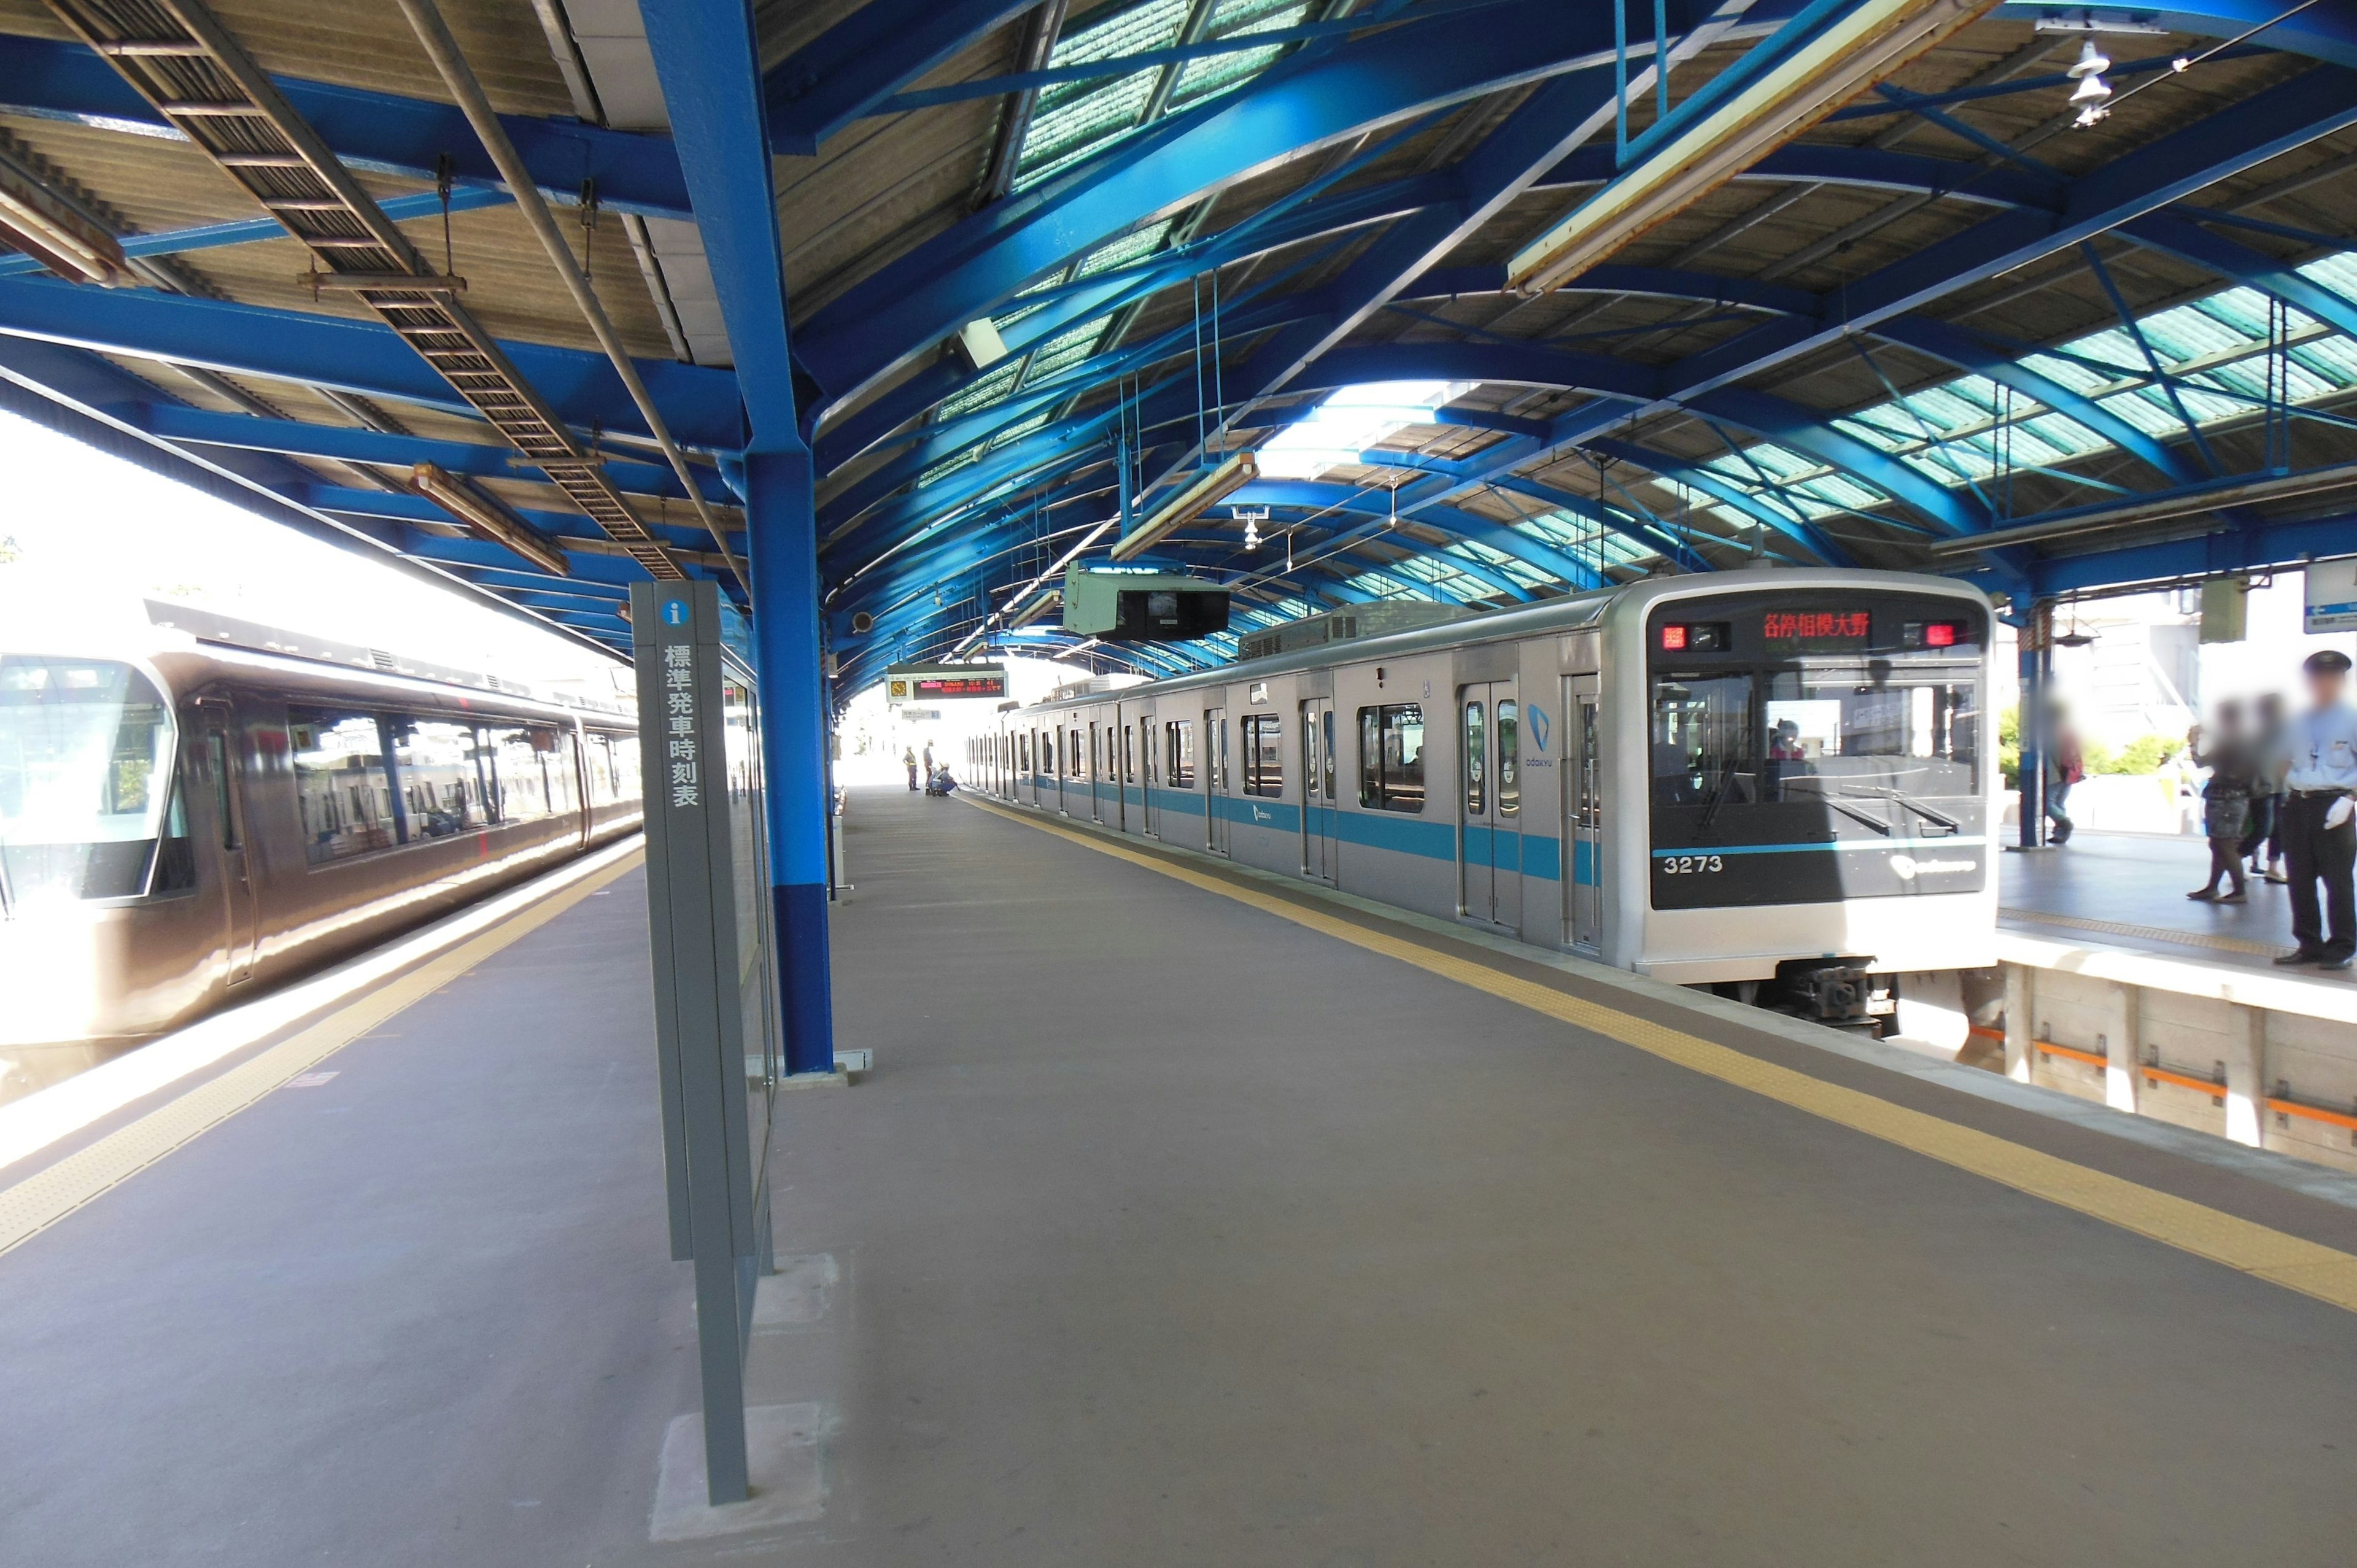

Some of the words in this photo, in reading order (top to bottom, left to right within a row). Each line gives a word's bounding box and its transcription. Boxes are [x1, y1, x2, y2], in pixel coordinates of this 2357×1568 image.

[1764, 612, 1870, 638] 各停相模大野
[665, 646, 699, 808] 標準発車時刻表
[1663, 855, 1723, 874] 3273
